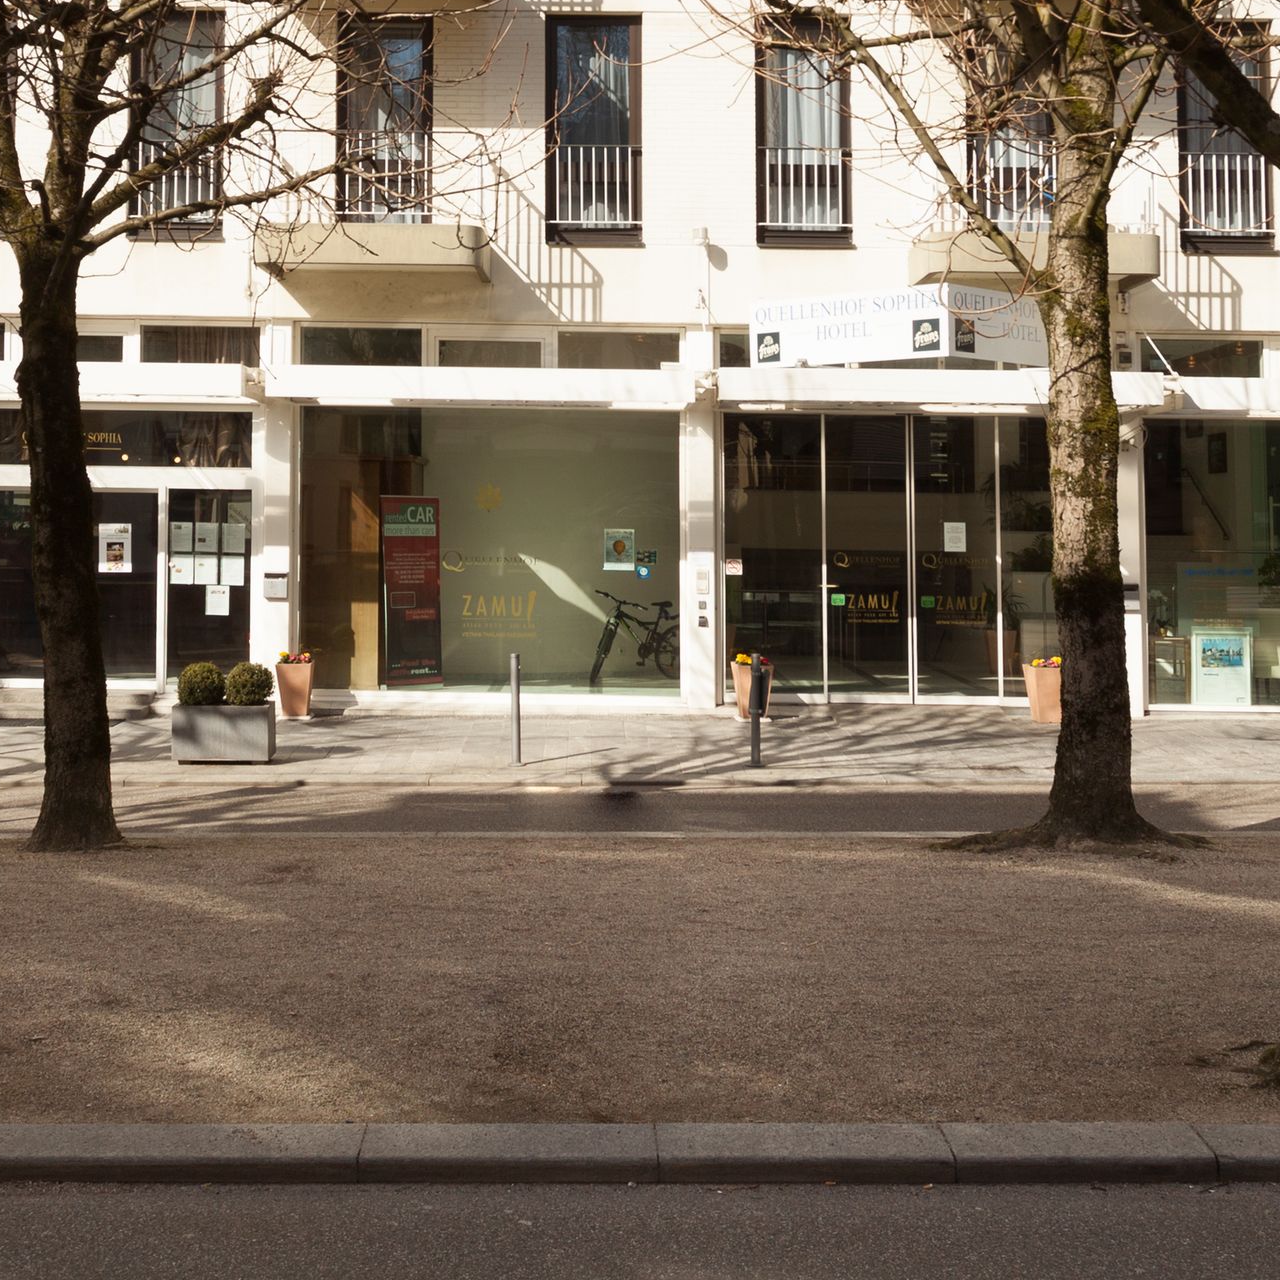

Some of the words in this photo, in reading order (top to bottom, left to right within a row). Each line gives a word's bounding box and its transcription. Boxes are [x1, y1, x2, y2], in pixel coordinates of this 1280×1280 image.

[755, 297, 865, 325] QUELLENHOF
[872, 291, 940, 313] SOPHIA
[816, 321, 872, 341] HOTEL
[87, 432, 122, 444] SOPHIA
[407, 506, 434, 523] CAR
